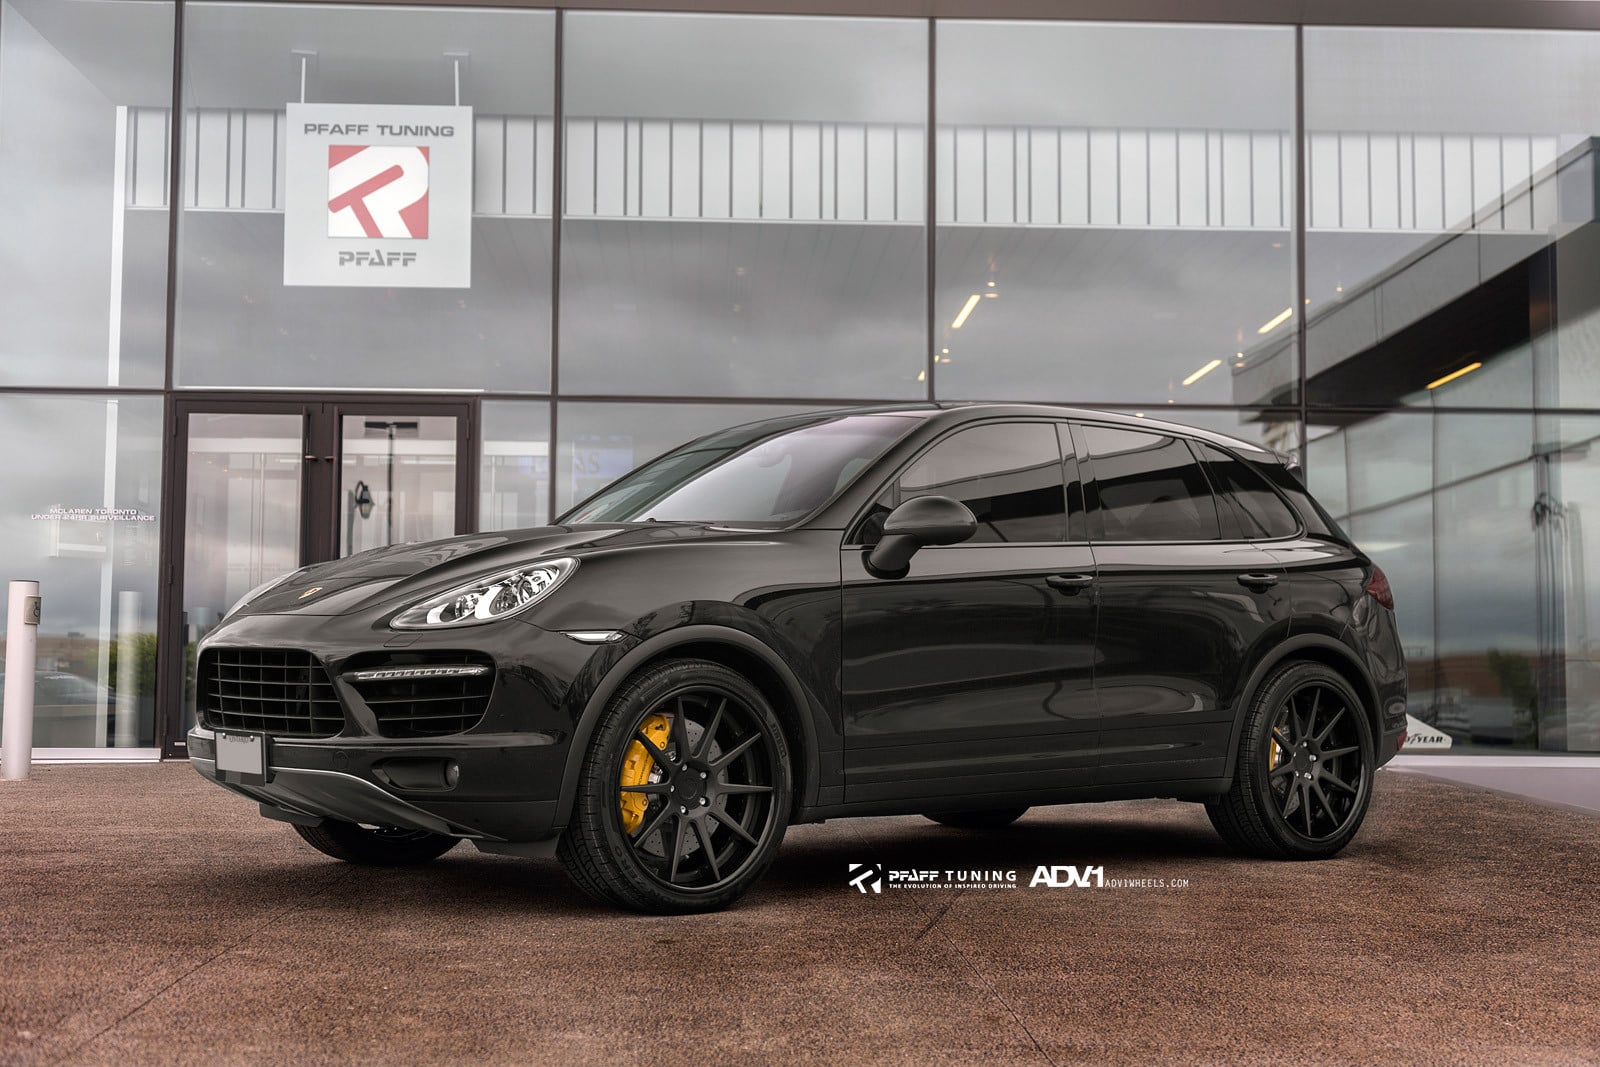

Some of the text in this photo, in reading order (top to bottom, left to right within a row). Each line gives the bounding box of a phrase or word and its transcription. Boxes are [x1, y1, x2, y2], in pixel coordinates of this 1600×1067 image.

[304, 123, 455, 137] PFAFF TUNING
[338, 249, 417, 267] PFAFF
